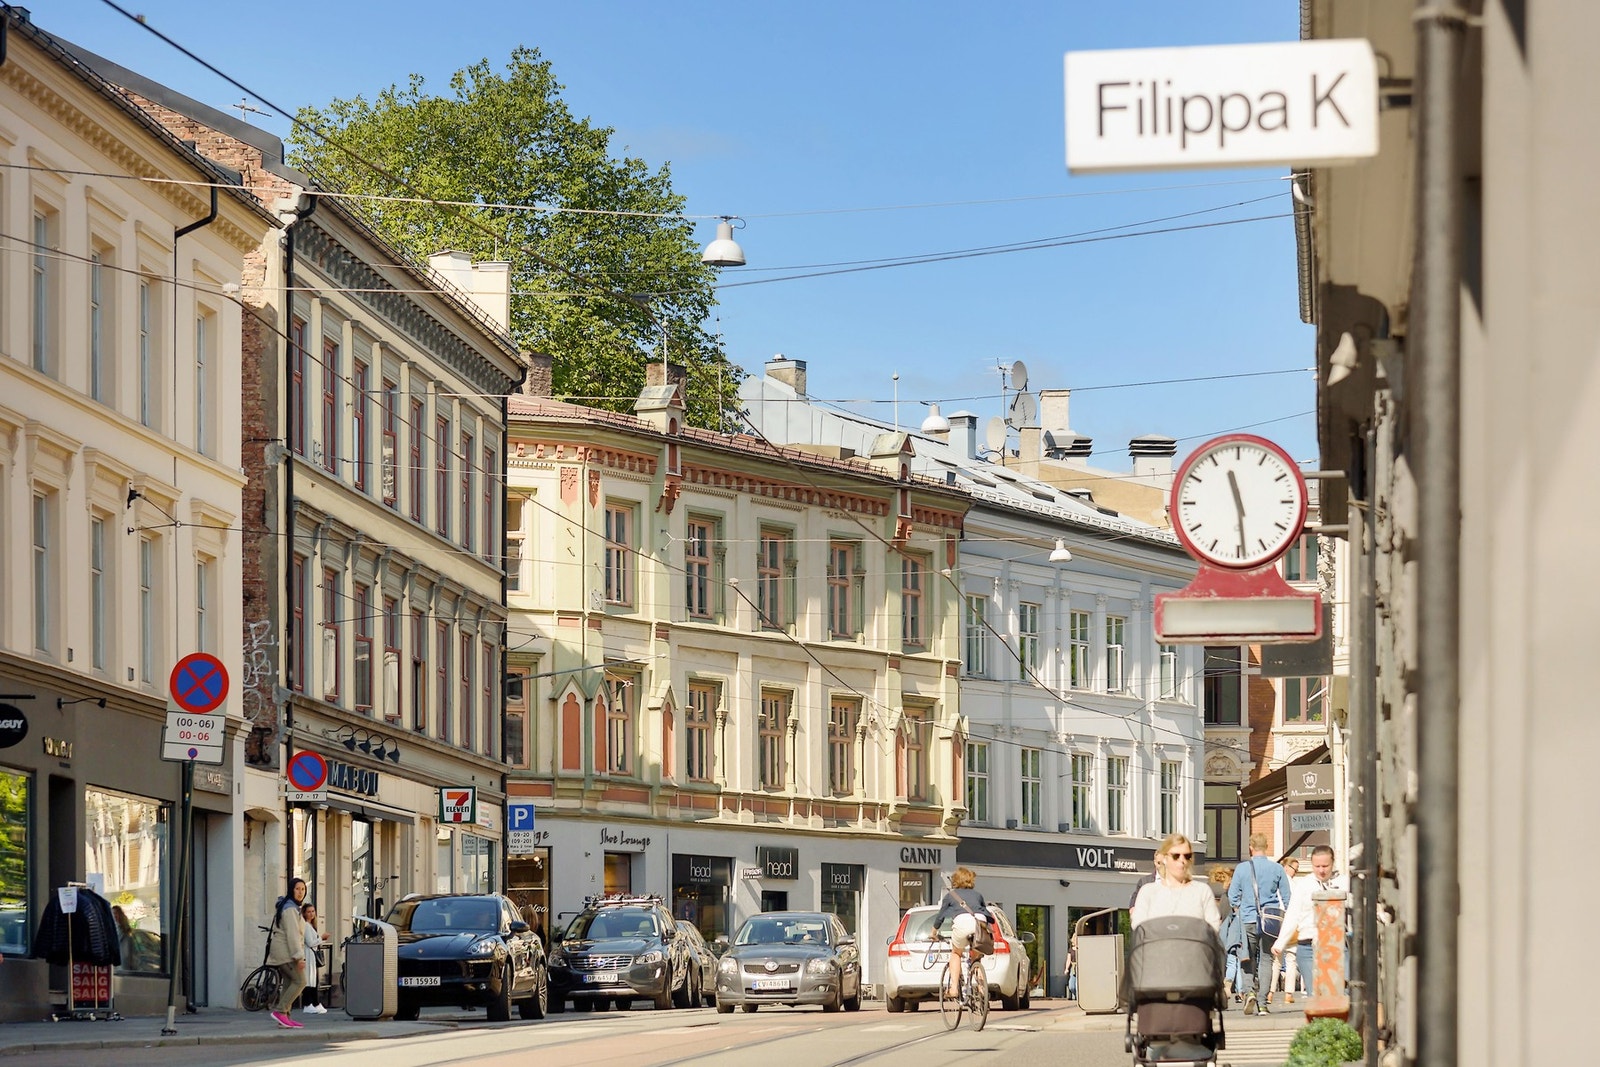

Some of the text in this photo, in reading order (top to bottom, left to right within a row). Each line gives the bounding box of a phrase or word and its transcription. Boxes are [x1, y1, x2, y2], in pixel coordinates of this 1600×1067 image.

[1097, 72, 1351, 150] Filippa K
[447, 791, 469, 823] 7
[514, 807, 529, 828] P
[1292, 814, 1322, 822] STUDIO
[600, 827, 651, 852] Shoe Lounge
[766, 850, 792, 876] head
[900, 847, 942, 864] GANNI
[1076, 847, 1115, 868] VOLT
[690, 857, 711, 878] head
[830, 864, 851, 885] head
[404, 977, 438, 985] BT 15936
